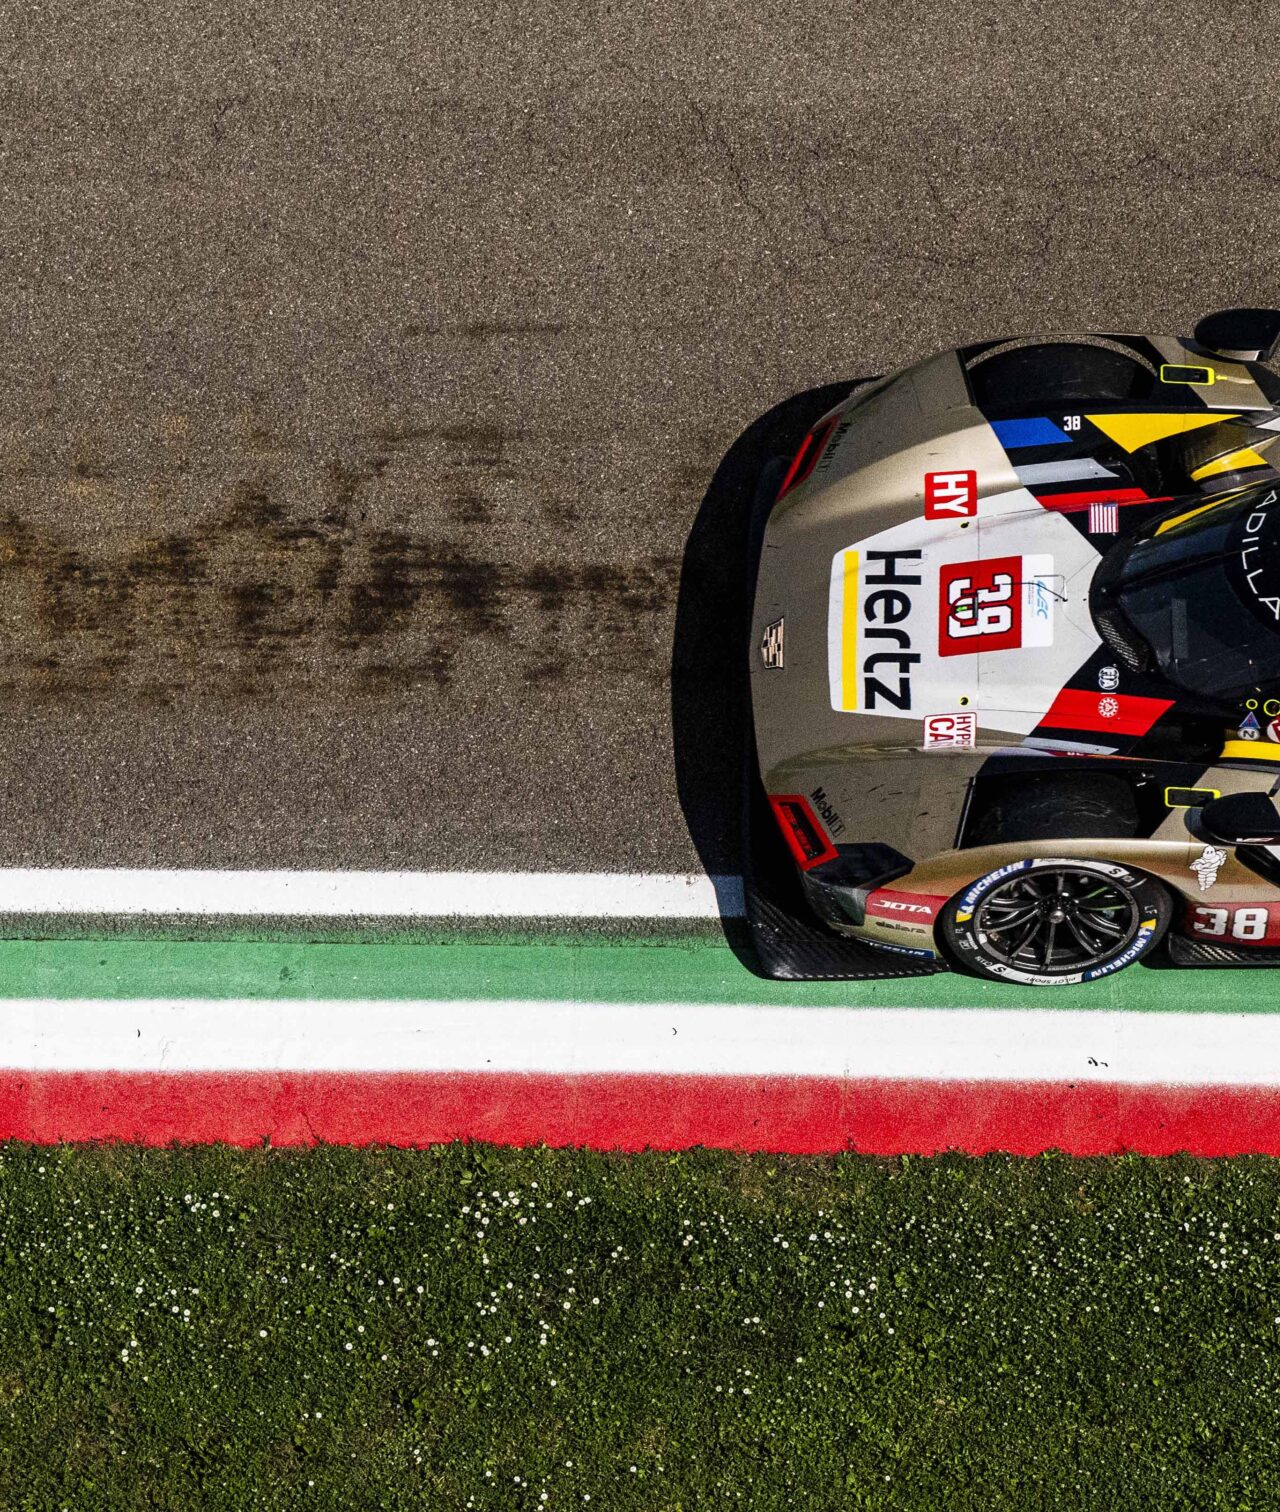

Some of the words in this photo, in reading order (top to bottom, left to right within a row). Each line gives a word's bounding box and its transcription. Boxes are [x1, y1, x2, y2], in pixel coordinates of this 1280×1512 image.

[1063, 415, 1081, 431] 38
[933, 473, 969, 515] HY
[948, 574, 1012, 639] 38
[863, 549, 922, 711] Hertz
[1100, 668, 1119, 689] FIA
[928, 717, 955, 748] CA
[956, 715, 972, 746] HYP
[810, 786, 839, 826] Mobil
[965, 861, 1024, 904] MICHELIN
[871, 900, 933, 914] JOTA
[1193, 907, 1270, 941] 38
[875, 920, 927, 935] dallara
[1091, 937, 1148, 978] MICHELIN
